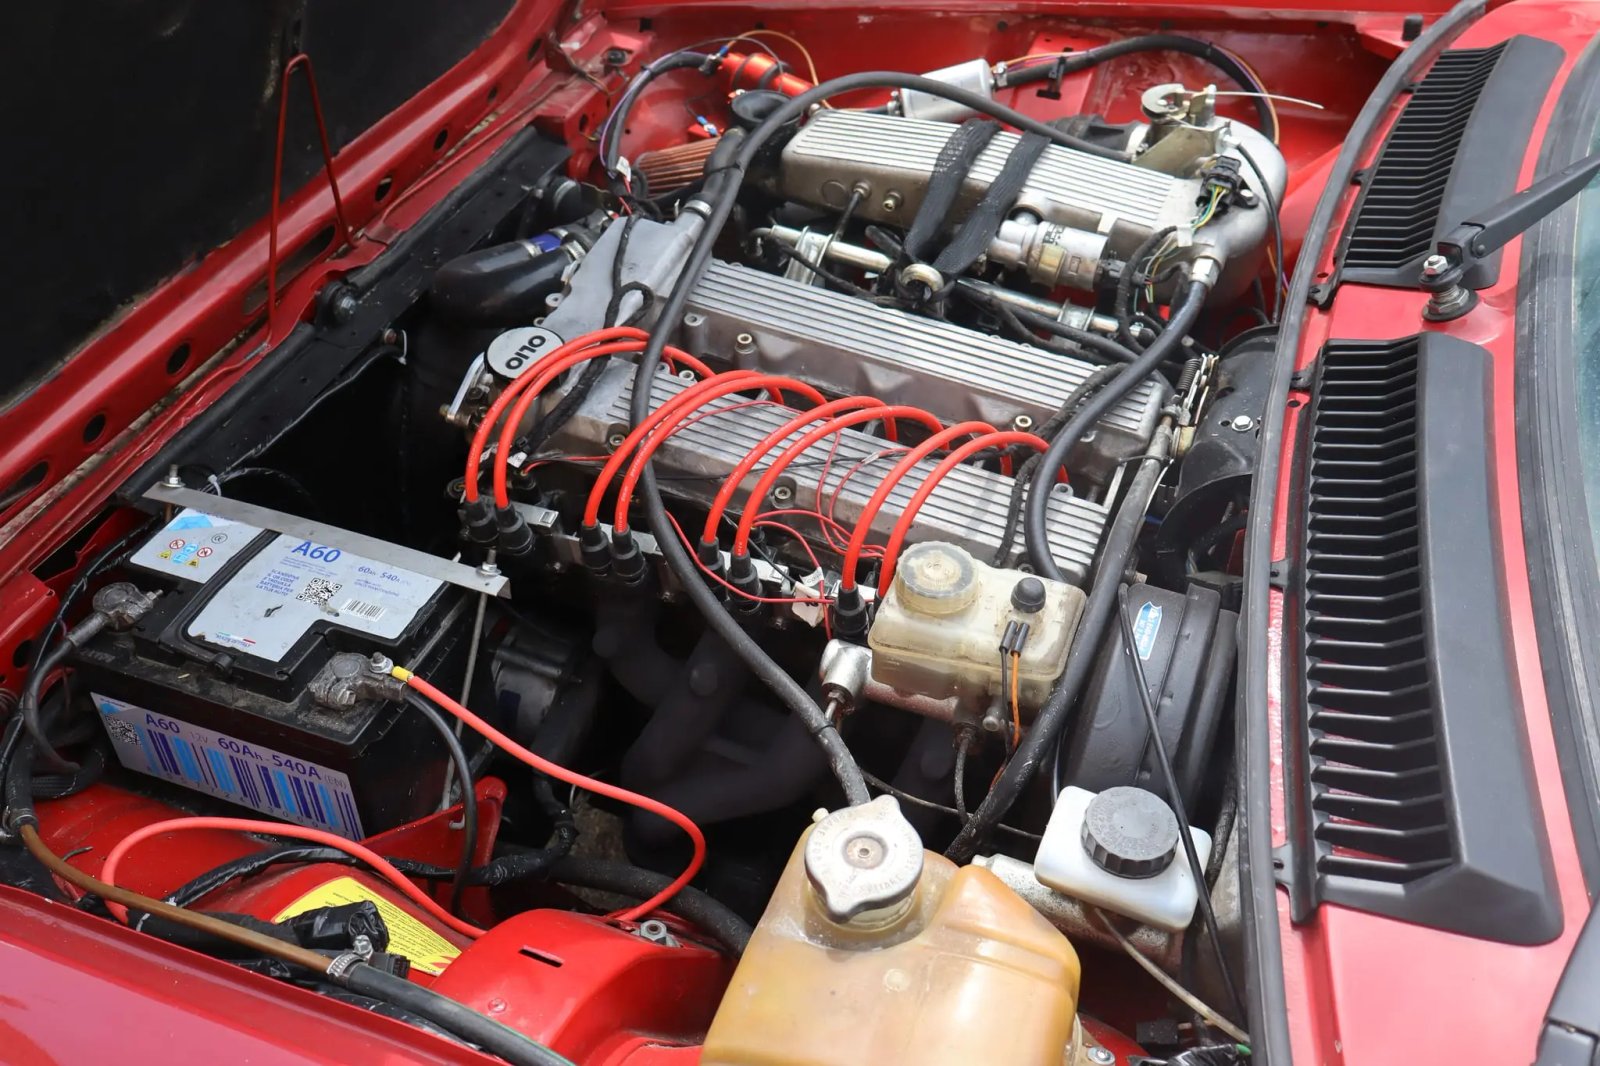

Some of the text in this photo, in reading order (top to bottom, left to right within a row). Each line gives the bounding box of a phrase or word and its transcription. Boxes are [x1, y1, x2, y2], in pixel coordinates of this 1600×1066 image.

[505, 335, 546, 370] OLIO
[291, 541, 341, 563] A60
[145, 713, 180, 734] A60
[217, 737, 263, 761] 60Ah
[272, 754, 322, 781] 540A
